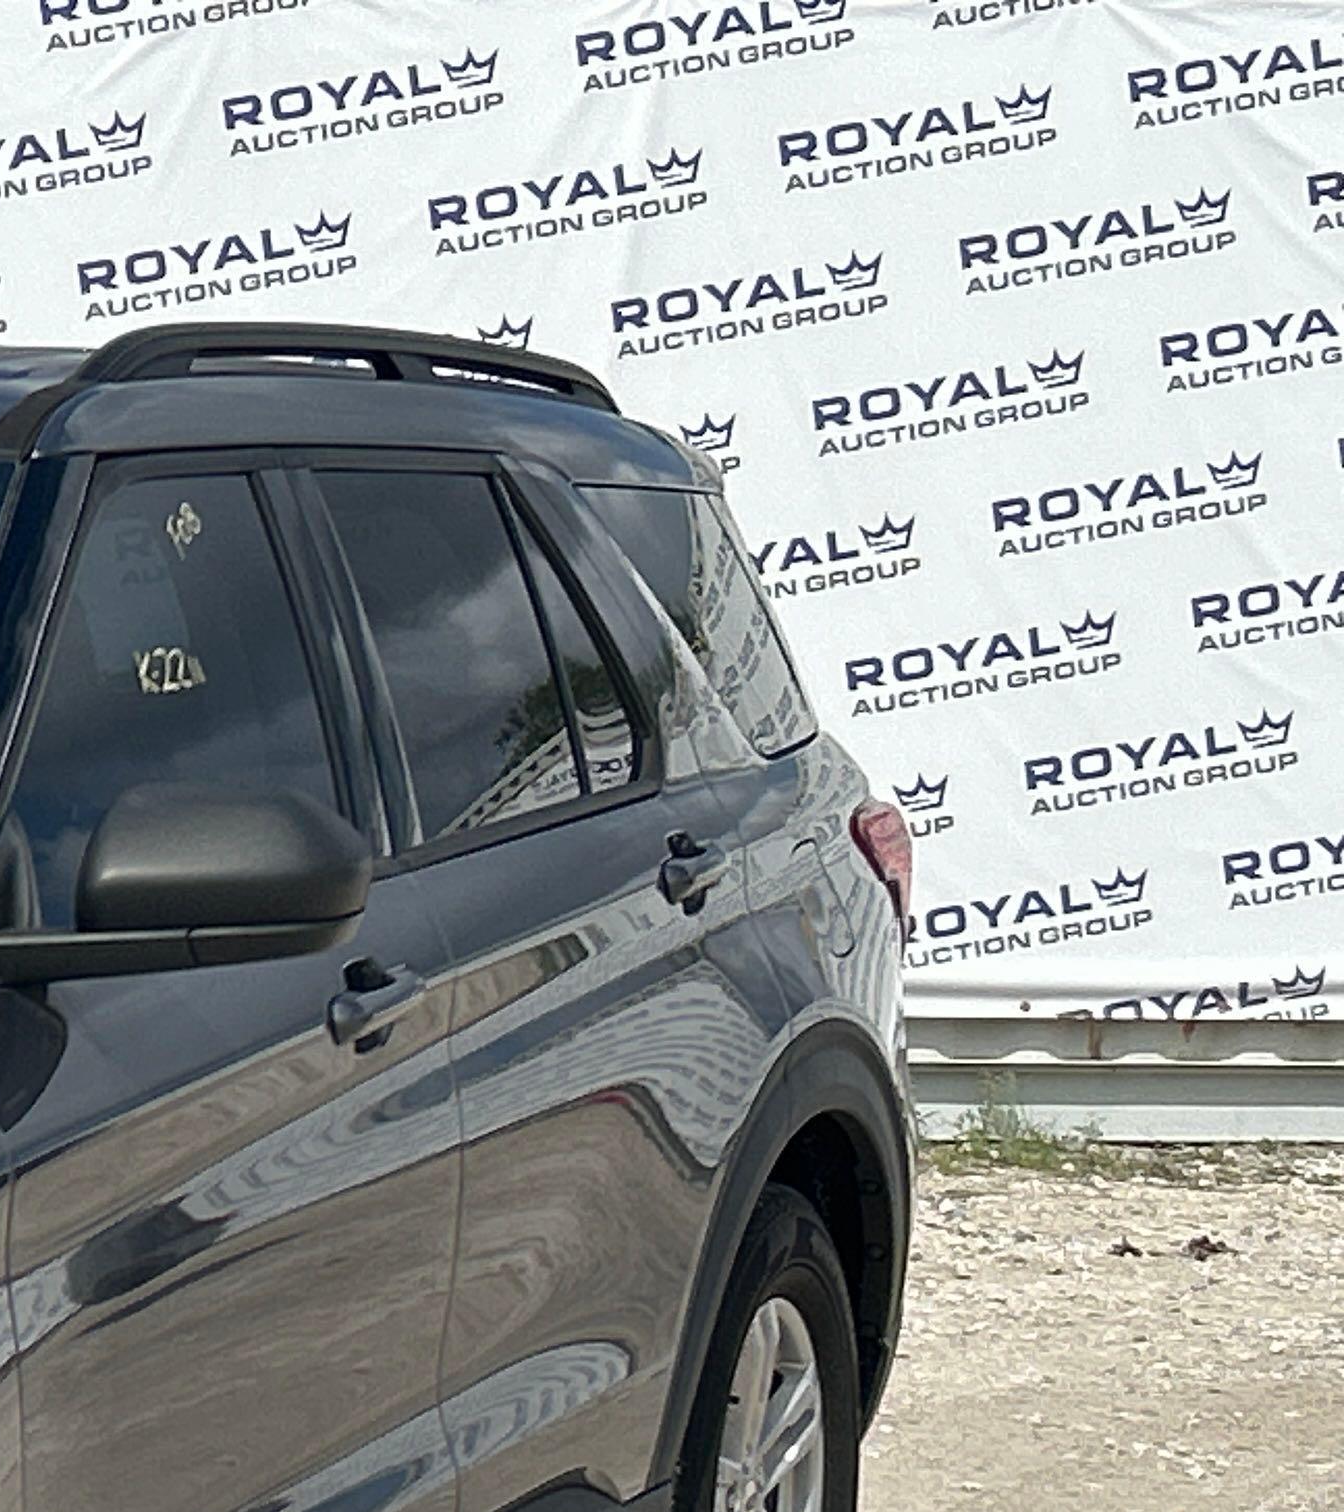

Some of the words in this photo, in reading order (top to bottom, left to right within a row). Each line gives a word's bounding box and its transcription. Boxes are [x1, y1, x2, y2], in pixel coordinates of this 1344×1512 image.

[45, 9, 197, 53] AUCTION
[575, 1, 793, 68] ROYAL
[583, 49, 731, 94] AUCTION
[737, 28, 855, 65] GROUP
[222, 63, 442, 131] ROYAL
[1127, 38, 1344, 104] ROYAL
[230, 113, 380, 158] AUCTION
[386, 92, 504, 129] GROUP
[777, 101, 996, 168] ROYAL
[1134, 86, 1281, 130] AUCTION
[35, 155, 153, 192] GROUP
[784, 149, 934, 194] AUCTION
[940, 128, 1057, 165] GROUP
[427, 163, 648, 232] ROYAL
[435, 213, 584, 257] AUCTION
[591, 190, 708, 228] GROUP
[76, 228, 296, 296] ROYAL
[958, 204, 1175, 271] ROYAL
[965, 253, 1113, 296] AUCTION
[1119, 230, 1237, 267] GROUP
[85, 278, 232, 322] AUCTION
[239, 254, 357, 292] GROUP
[610, 267, 826, 334] ROYAL
[617, 316, 765, 360] AUCTION
[771, 294, 888, 331] GROUP
[1159, 308, 1342, 368] ROYA
[811, 365, 1029, 431] ROYAL
[1166, 350, 1314, 394] AUCTION
[818, 414, 967, 458] AUCTION
[973, 391, 1090, 429] GROUP
[991, 466, 1208, 533] ROYAL
[998, 514, 1145, 558] AUCTION
[1151, 493, 1268, 529] GROUP
[804, 557, 921, 593] GROUP
[1190, 570, 1344, 629] ROY
[844, 626, 1061, 692] ROYAL
[1197, 611, 1344, 654] AUCTION
[851, 674, 1000, 718] AUCTION
[1006, 652, 1122, 689] GROUP
[1023, 726, 1238, 791] ROYAL
[1030, 773, 1177, 817] AUCTION
[1183, 751, 1299, 787] GROUP
[1221, 834, 1344, 886] ROY
[1228, 873, 1344, 911] AUCTIO
[907, 884, 1094, 941] OYAL
[908, 931, 1032, 969] UCTION
[1038, 908, 1153, 945] GROUP
